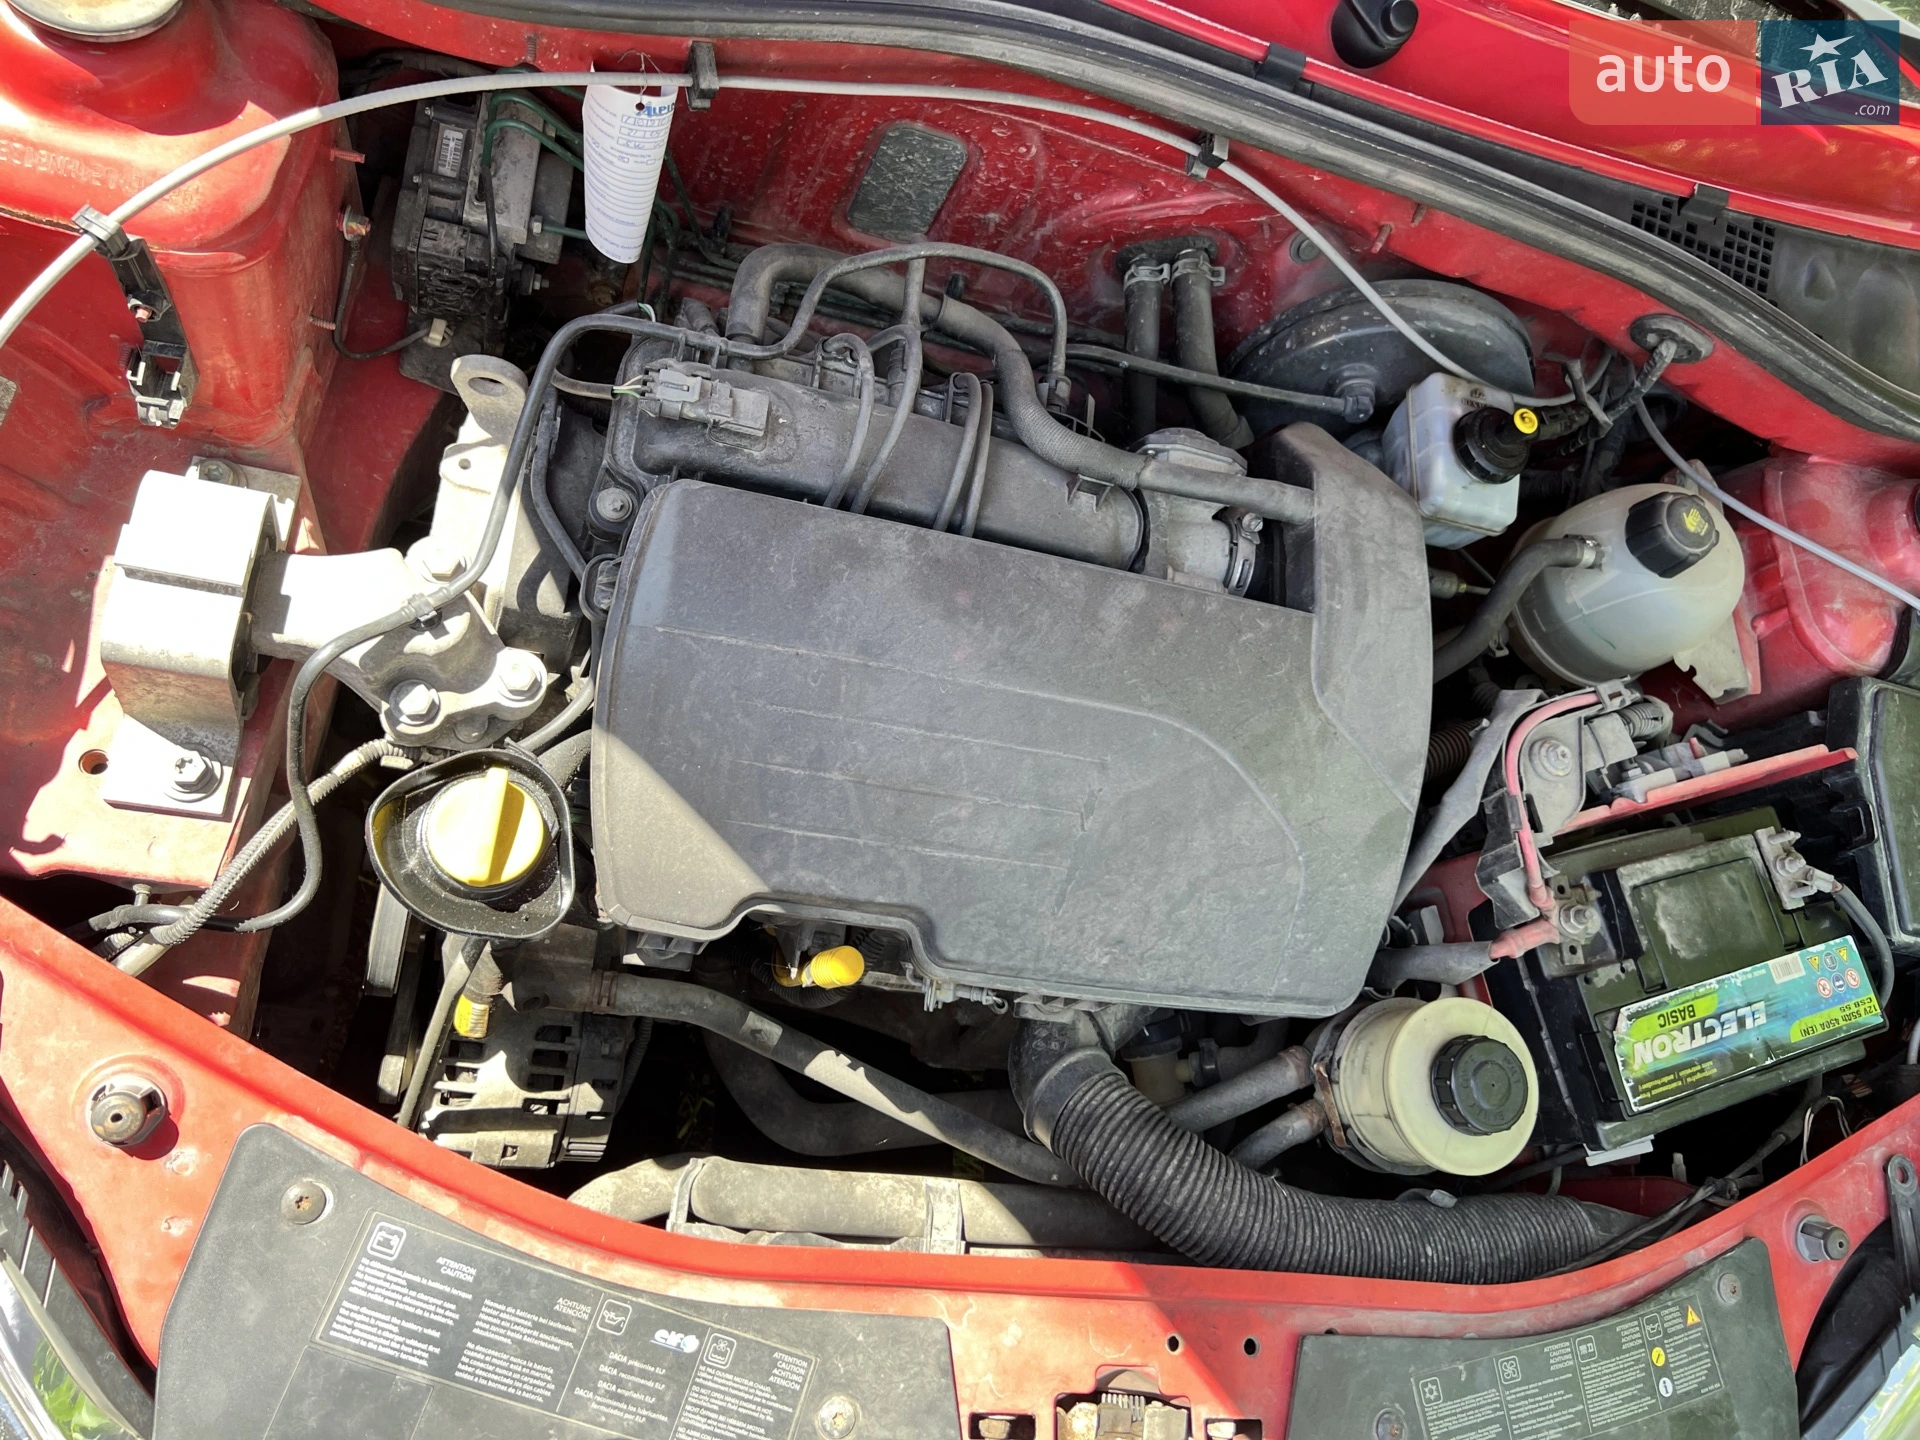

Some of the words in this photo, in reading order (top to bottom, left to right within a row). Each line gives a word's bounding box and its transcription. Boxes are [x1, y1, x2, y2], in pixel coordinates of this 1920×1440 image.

[1838, 1003, 1852, 1014] 55
[1852, 996, 1873, 1008] CSB
[1862, 1003, 1880, 1016] 12V
[1658, 1005, 1696, 1027] BASIC
[1840, 1009, 1862, 1023] 55Ah
[1633, 1001, 1767, 1069] ELECTRON
[435, 1256, 477, 1275] ATTENTION
[440, 1266, 474, 1283] CAUTION
[553, 1304, 589, 1320] ATENCIÓN
[557, 1297, 592, 1313] ACHTUNG
[1544, 1342, 1570, 1352] ATTENTION
[1550, 1348, 1571, 1357] CAUTION
[608, 1351, 627, 1363] DACIA
[773, 1352, 808, 1368] ATTENTION
[1550, 1354, 1572, 1364] ACHTUNG
[777, 1361, 806, 1375] CAUTION
[1550, 1360, 1573, 1371] ATENCIÓN
[599, 1364, 617, 1376] DACIA
[618, 1372, 654, 1387] recommends
[768, 1375, 800, 1391] ATENCIÓN
[772, 1368, 803, 1383] ACHTUNG
[597, 1380, 616, 1392] DACIA
[574, 1387, 593, 1400] DACIA
[593, 1395, 627, 1410] recomienda
[627, 1404, 636, 1412] los
[700, 1388, 711, 1396] NOT
[710, 1391, 724, 1400] OPEN
[724, 1395, 739, 1405] WHEN
